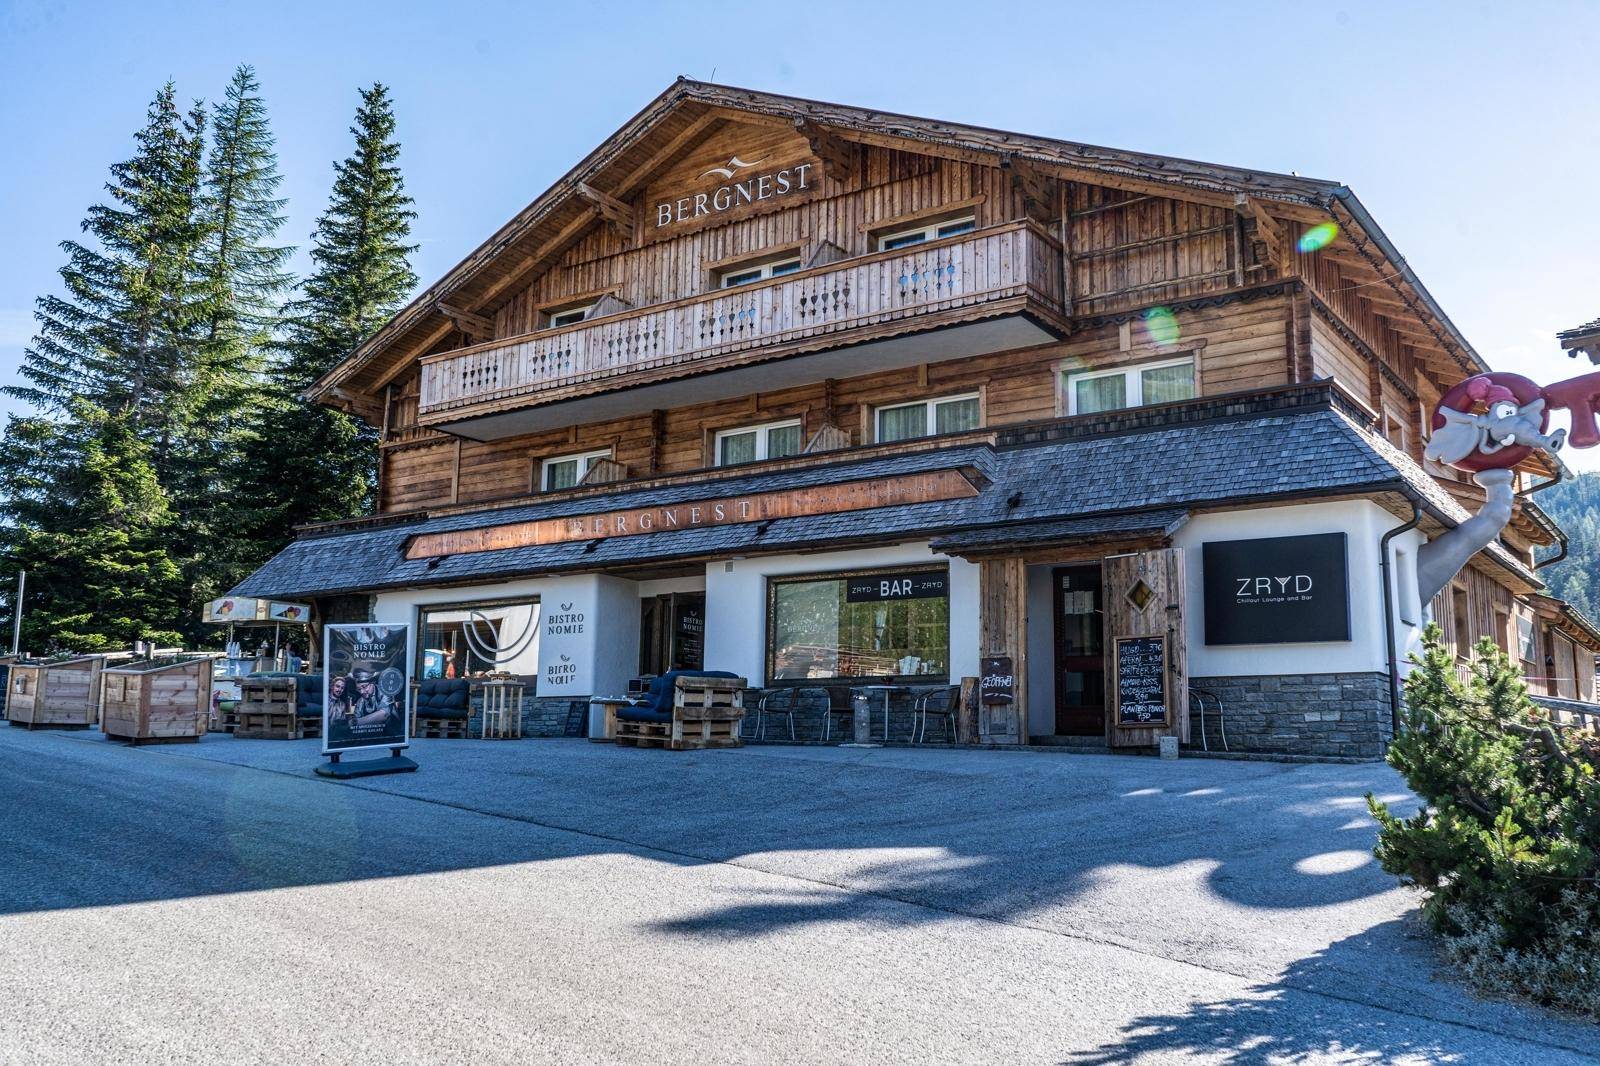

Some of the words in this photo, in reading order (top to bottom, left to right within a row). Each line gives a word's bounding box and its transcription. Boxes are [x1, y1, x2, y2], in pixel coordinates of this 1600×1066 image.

[656, 163, 811, 228] BERGNEST
[571, 501, 750, 538] BERGNEST
[880, 579, 913, 597] BAR
[1236, 575, 1313, 596] ZRYD
[548, 613, 584, 625] BISTRO
[548, 624, 584, 635] NOMIE
[353, 643, 386, 652] BISTRO
[353, 651, 386, 659] NOMIE
